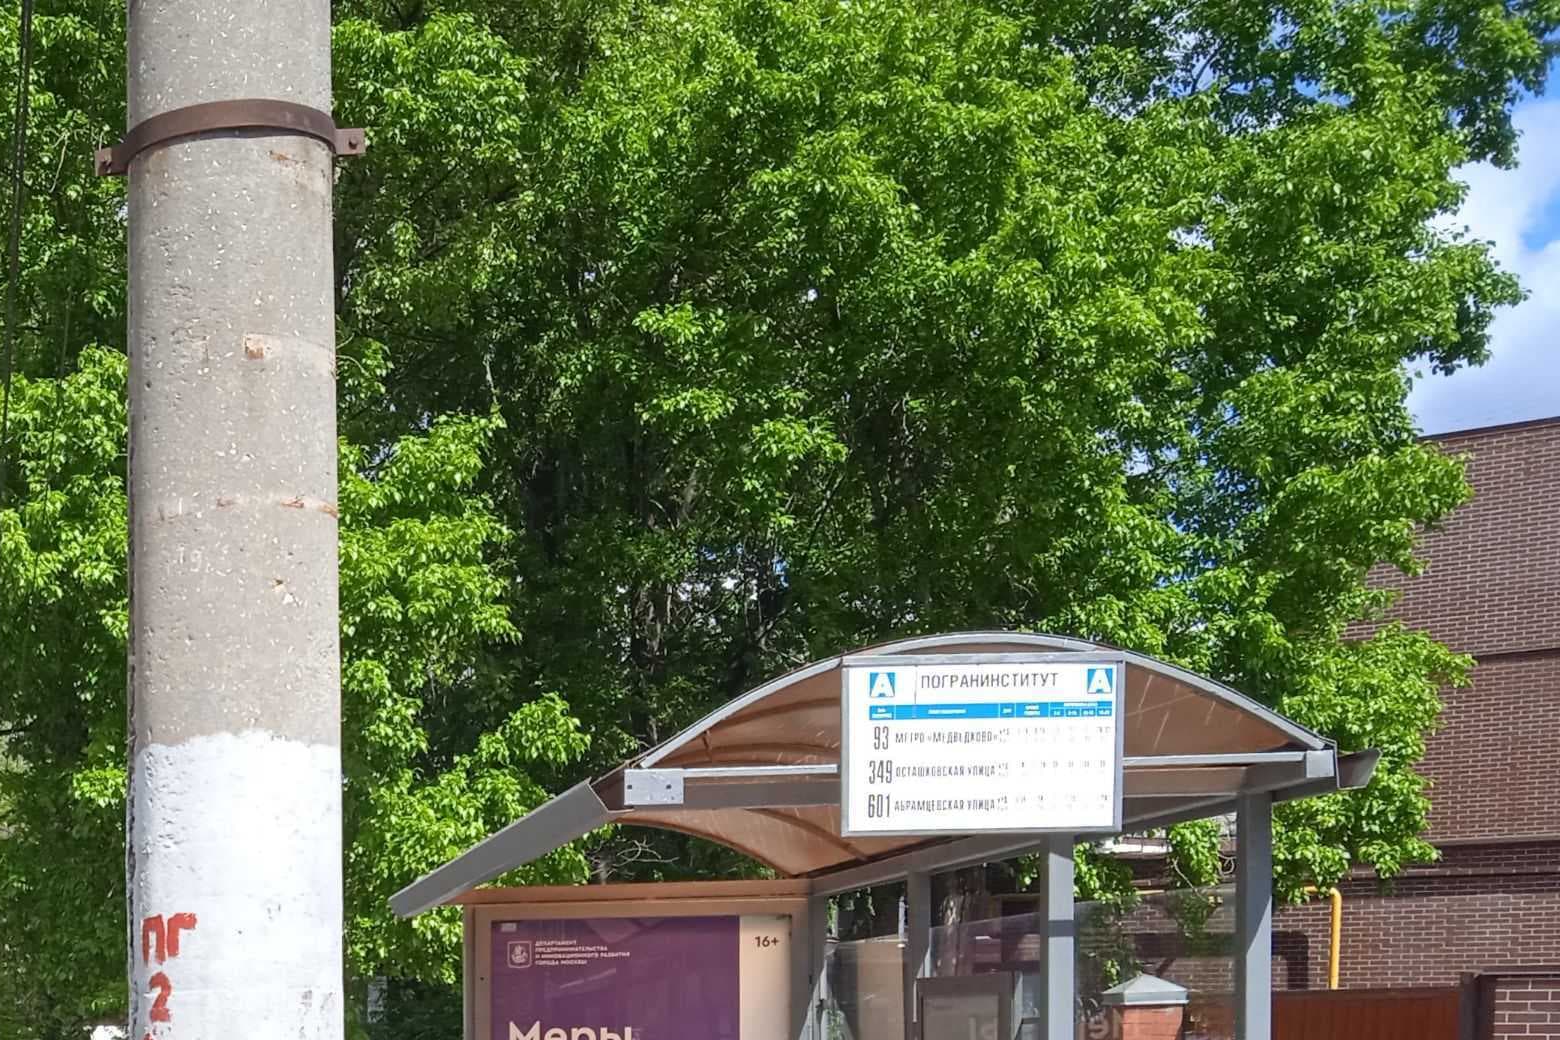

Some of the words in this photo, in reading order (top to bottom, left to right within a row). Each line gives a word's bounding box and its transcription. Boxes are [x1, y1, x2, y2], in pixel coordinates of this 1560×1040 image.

[921, 673, 1059, 689] ПОГРАНИНСТИТУТ
[874, 726, 889, 750] 93
[869, 760, 893, 784] 349
[896, 766, 964, 777] ОСТАШКОВСКАЯ
[968, 765, 996, 777] УЛИЦА
[868, 794, 890, 818] 601
[968, 799, 995, 811] УЛИЦА
[755, 935, 779, 948] 16+
[149, 972, 172, 1022] 2
